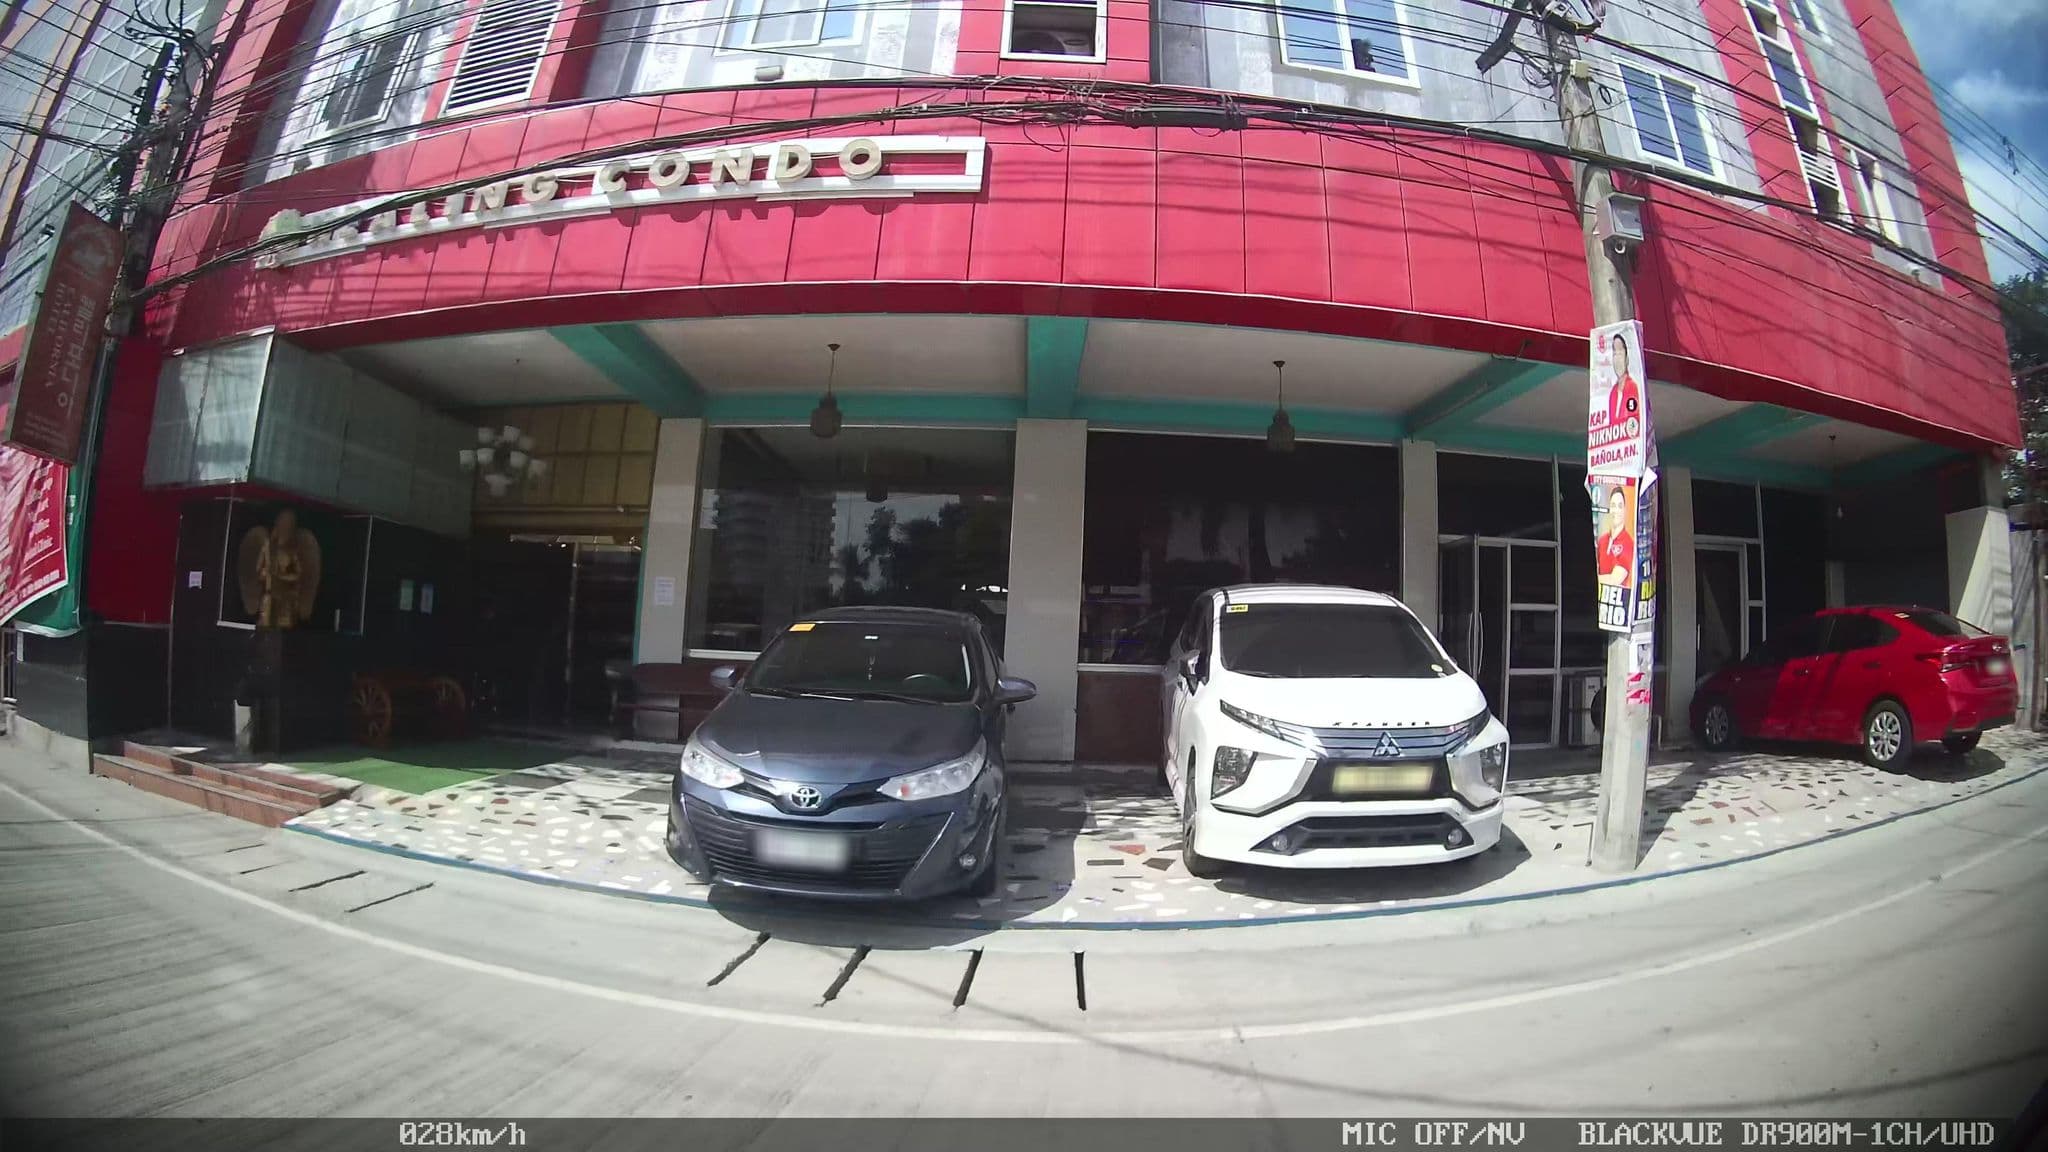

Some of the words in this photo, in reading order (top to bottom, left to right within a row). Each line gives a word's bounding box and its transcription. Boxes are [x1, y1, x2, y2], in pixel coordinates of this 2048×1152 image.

[599, 138, 882, 193] CONDO
[1589, 410, 1607, 427] KAP
[1589, 421, 1627, 448] NIKNOK
[1599, 604, 1626, 626] RIO
